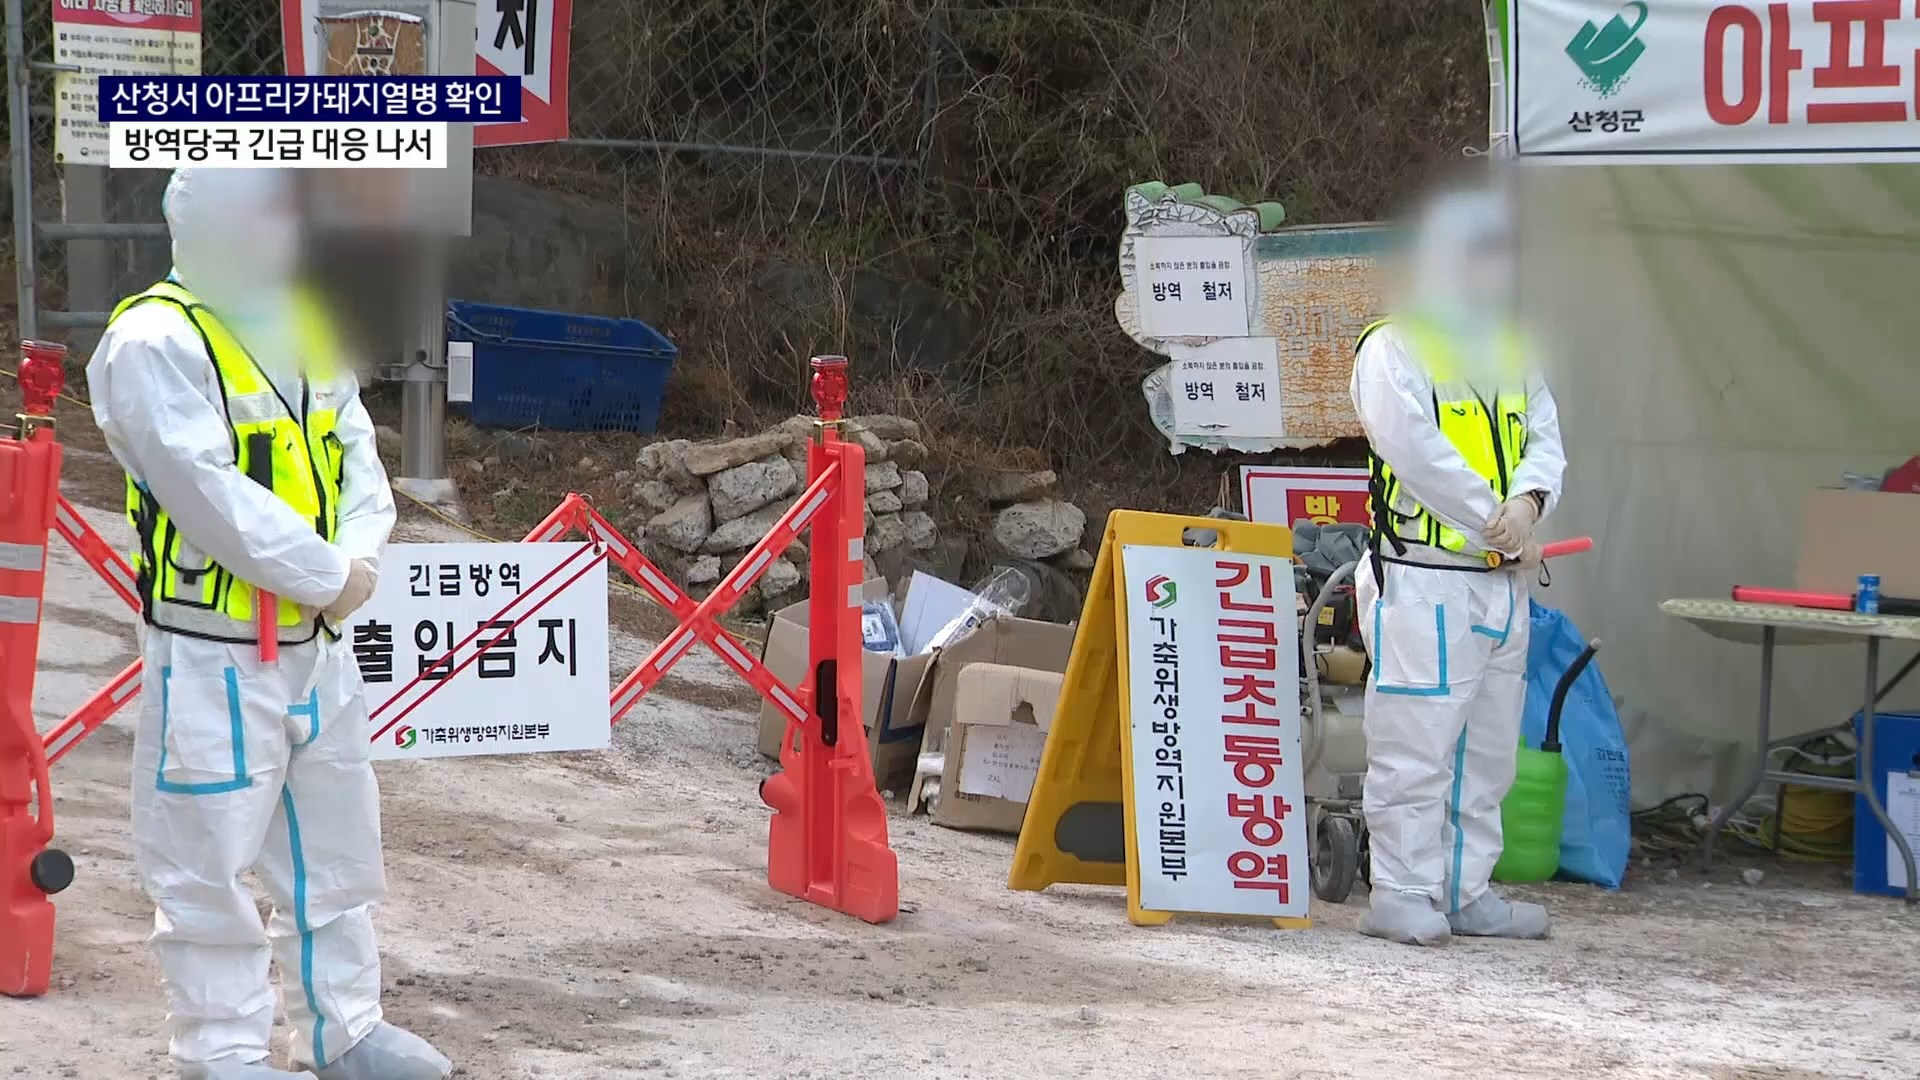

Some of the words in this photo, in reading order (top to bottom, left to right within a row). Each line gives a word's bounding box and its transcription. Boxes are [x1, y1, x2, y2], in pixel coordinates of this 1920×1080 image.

[1704, 0, 1920, 125] 아프
[1567, 110, 1645, 133] 산청군
[1152, 281, 1182, 302] 방역
[1202, 281, 1232, 301] 철저
[1185, 381, 1214, 401] 방역
[1235, 381, 1265, 402] 철저
[409, 562, 521, 597] 긴급방역
[352, 618, 577, 683] 출입금지
[421, 723, 550, 744] 가축위생방역지원본부
[1149, 616, 1188, 882] 가축위생방역지원본부
[1214, 560, 1293, 905] 긴급초동방역
